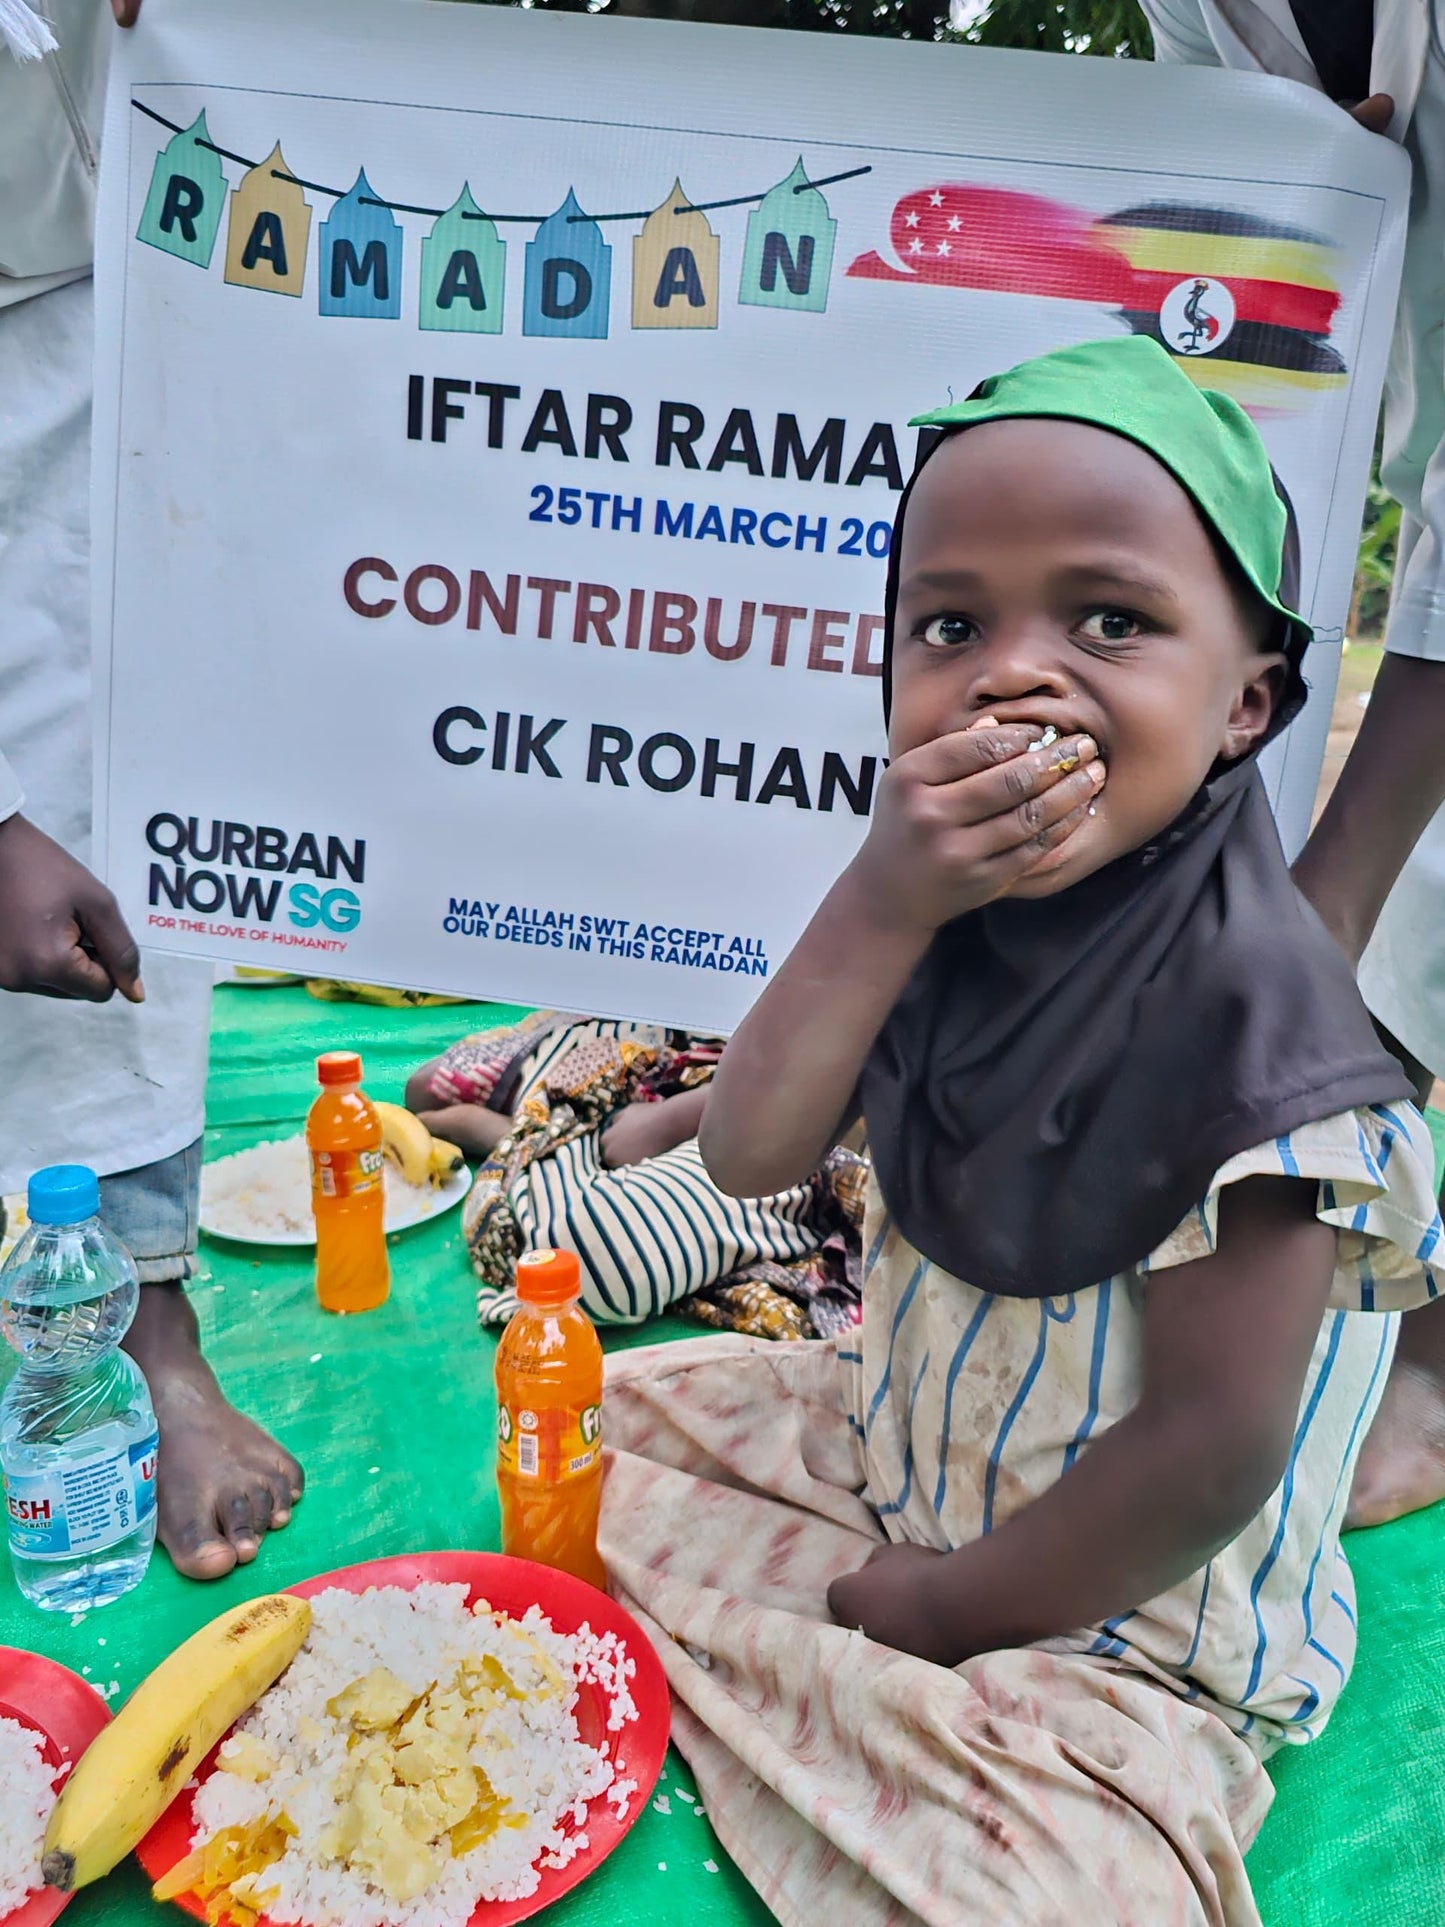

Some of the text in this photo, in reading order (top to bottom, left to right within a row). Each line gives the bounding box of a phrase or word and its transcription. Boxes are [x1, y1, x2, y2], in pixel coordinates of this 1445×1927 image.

[160, 175, 814, 319] RAMADAN
[407, 374, 633, 463] IFTAR
[529, 485, 642, 533] 25TH
[654, 500, 828, 553] MARCH
[432, 705, 893, 816] CIK ROHAN
[145, 812, 366, 883] QURBAN
[148, 862, 361, 933] NOW SG
[148, 914, 348, 952] FOR THE LOVE OF HUMANITY
[449, 898, 766, 957] MAY ALLAH SWT ACCEPT ALL
[443, 916, 768, 977] OUR DEEDS IN THIS RAMADAN
